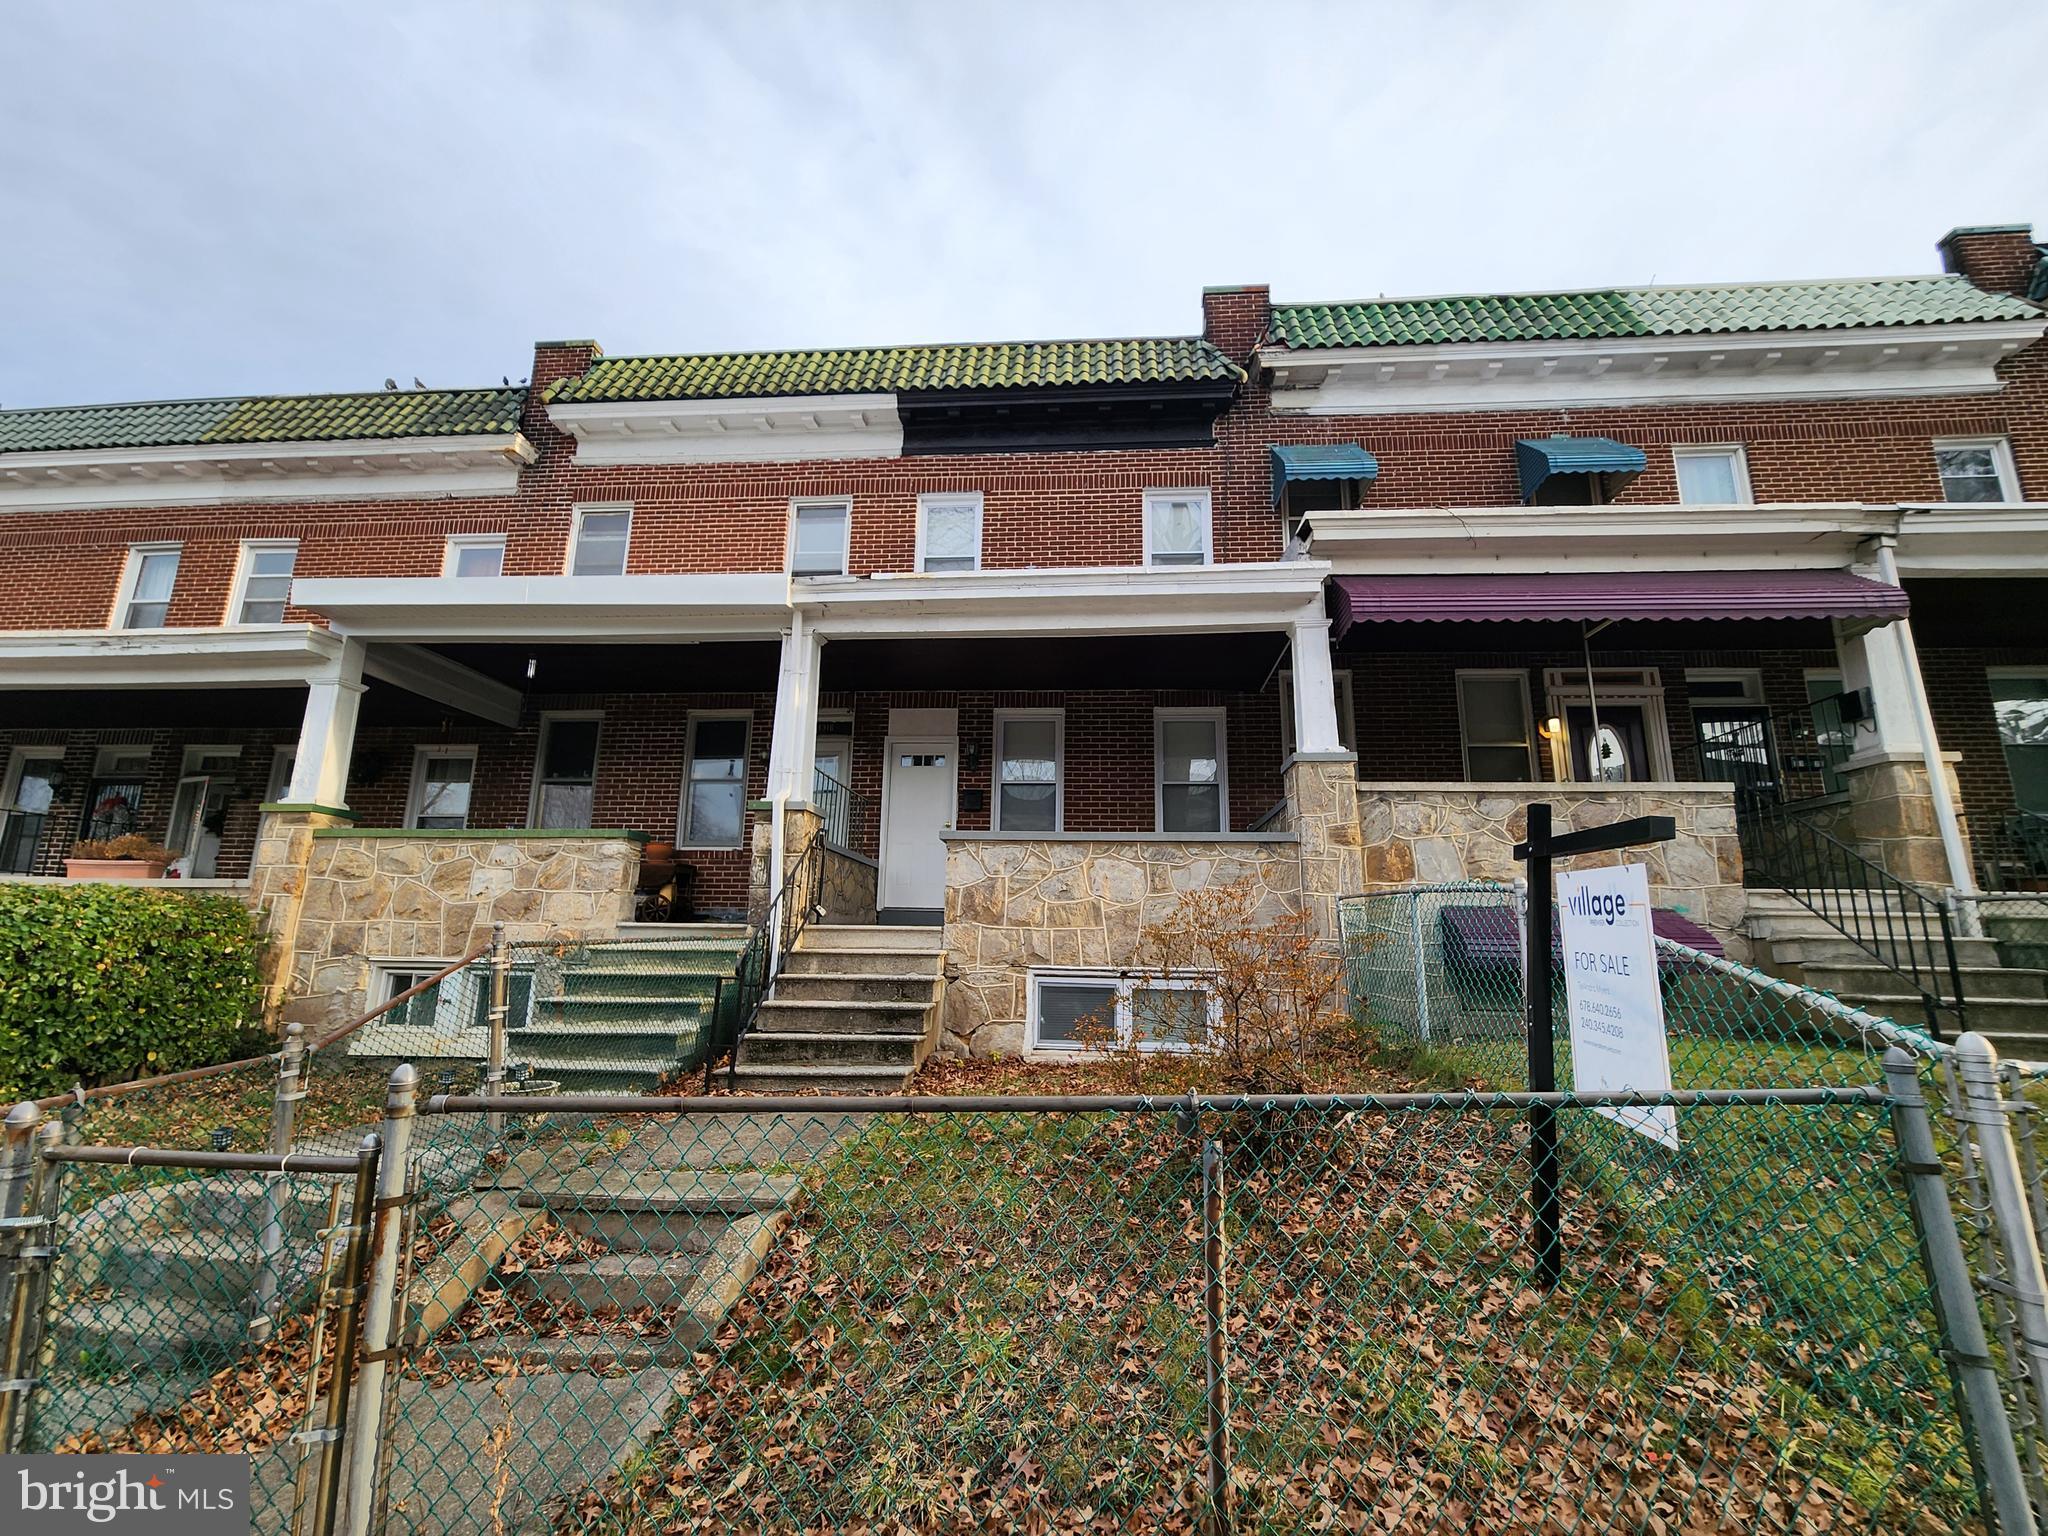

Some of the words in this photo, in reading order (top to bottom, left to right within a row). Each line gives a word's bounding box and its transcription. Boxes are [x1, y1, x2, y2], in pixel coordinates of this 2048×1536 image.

[1568, 883, 1626, 925] village
[1575, 951, 1597, 973] FOR
[1600, 953, 1630, 977] SALE
